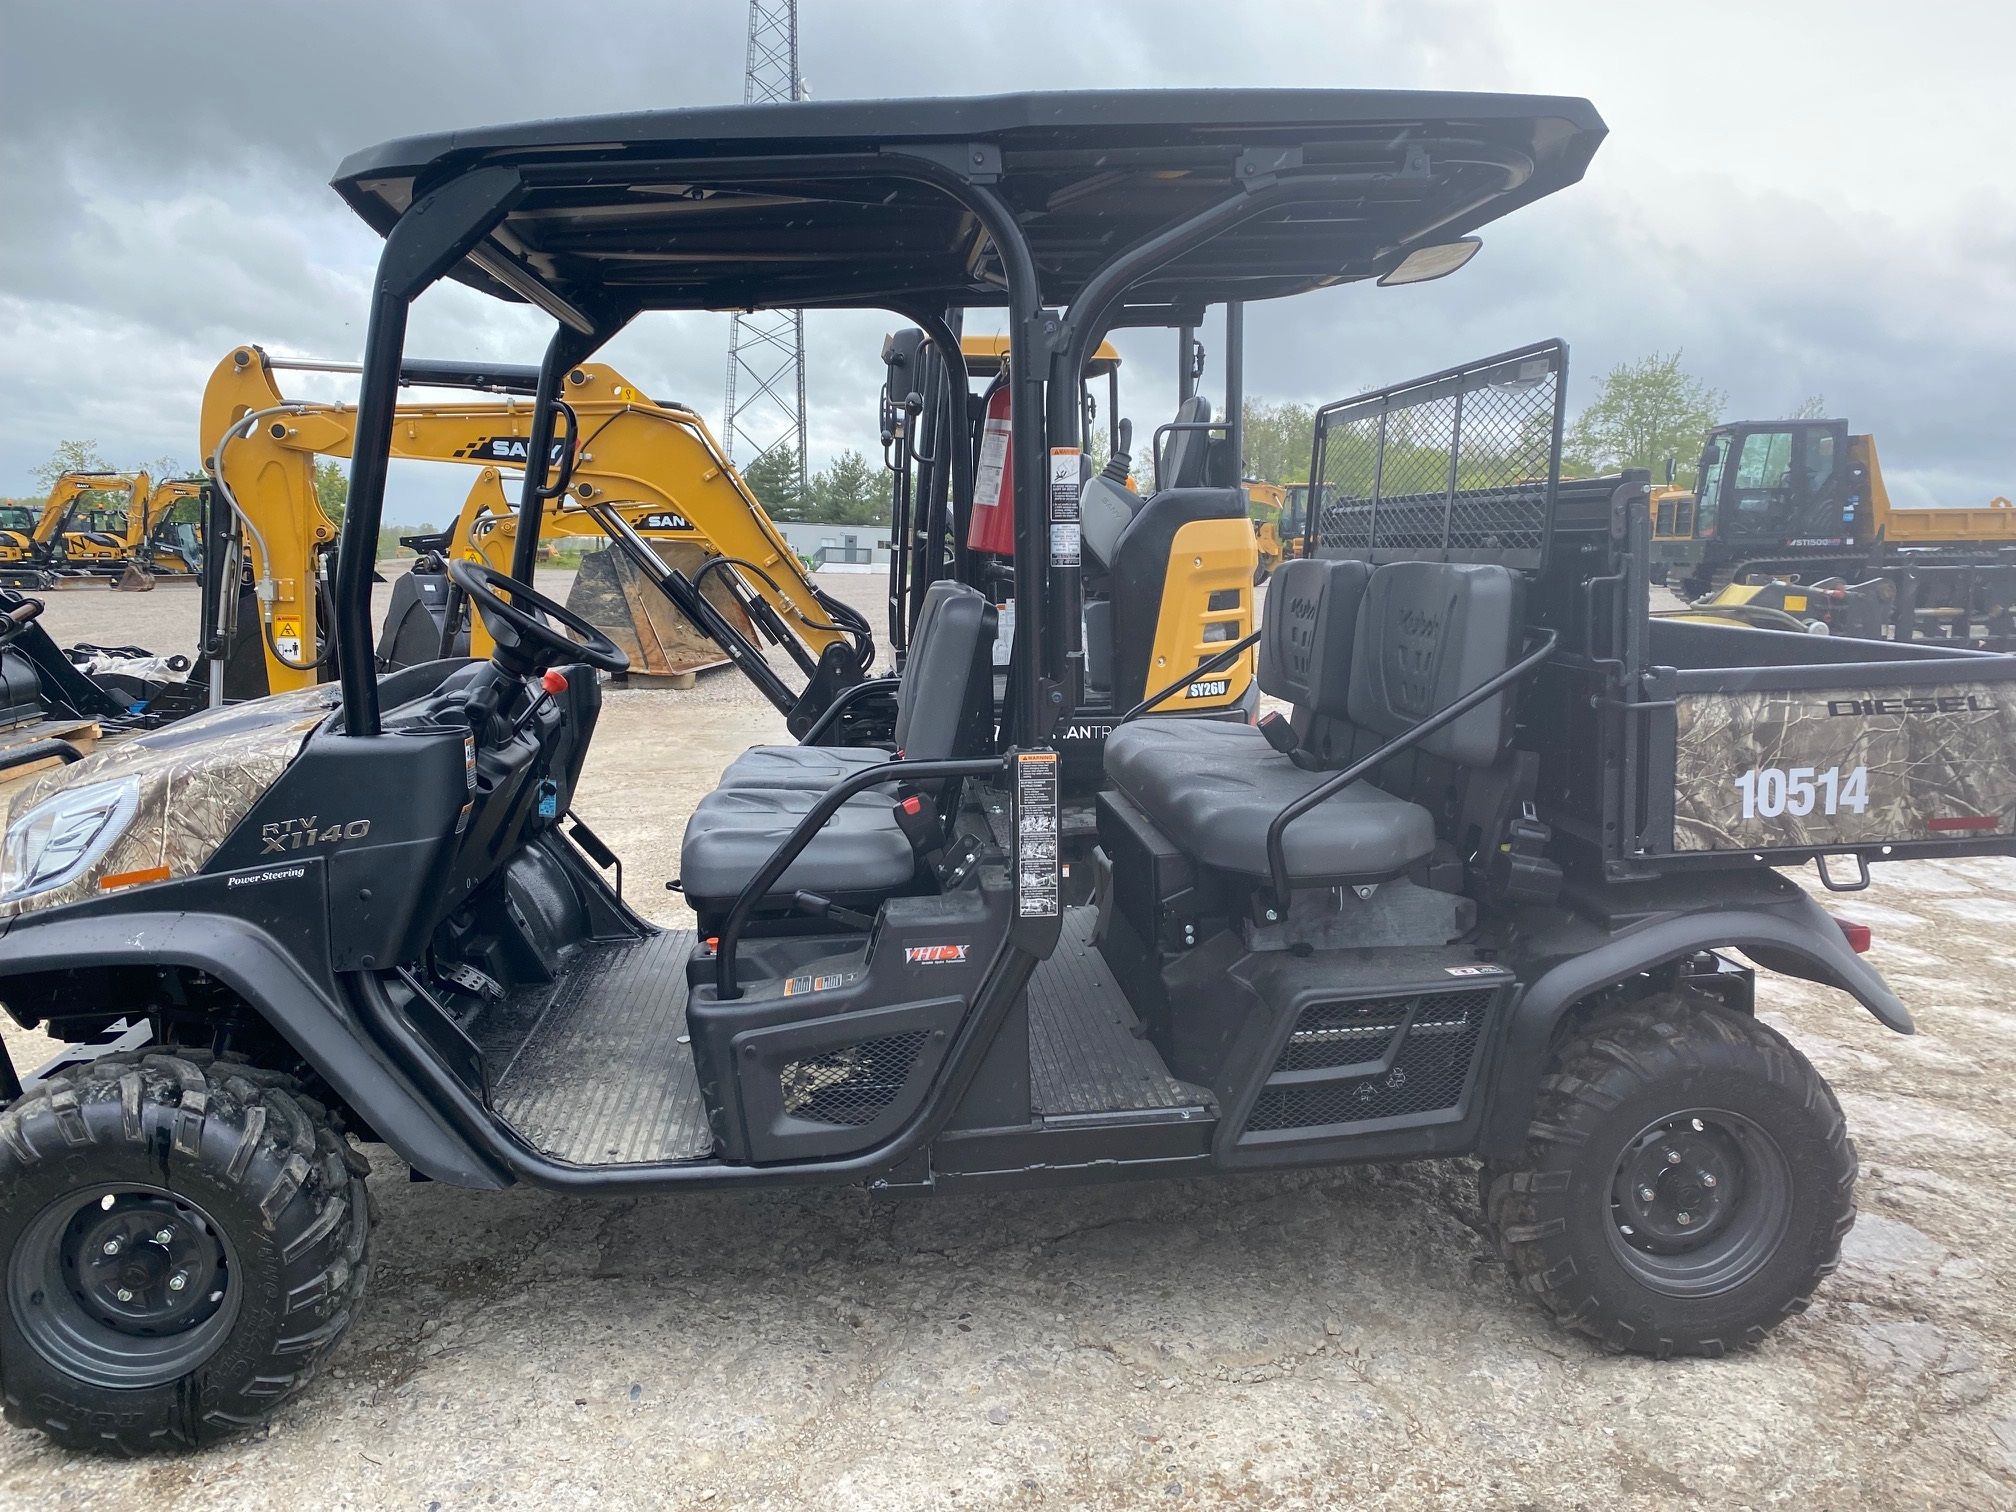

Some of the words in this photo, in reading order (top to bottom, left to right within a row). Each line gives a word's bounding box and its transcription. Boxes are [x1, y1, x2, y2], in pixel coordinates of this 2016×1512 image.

[493, 440, 562, 459] SAY
[648, 515, 692, 528] SAN
[1190, 681, 1226, 697] SY26U
[1827, 695, 2000, 717] DIESEL
[1735, 766, 1869, 819] 10514
[262, 815, 318, 837] RTV
[259, 819, 371, 855] X1140
[227, 875, 261, 887] Power
[262, 868, 305, 883] Steering
